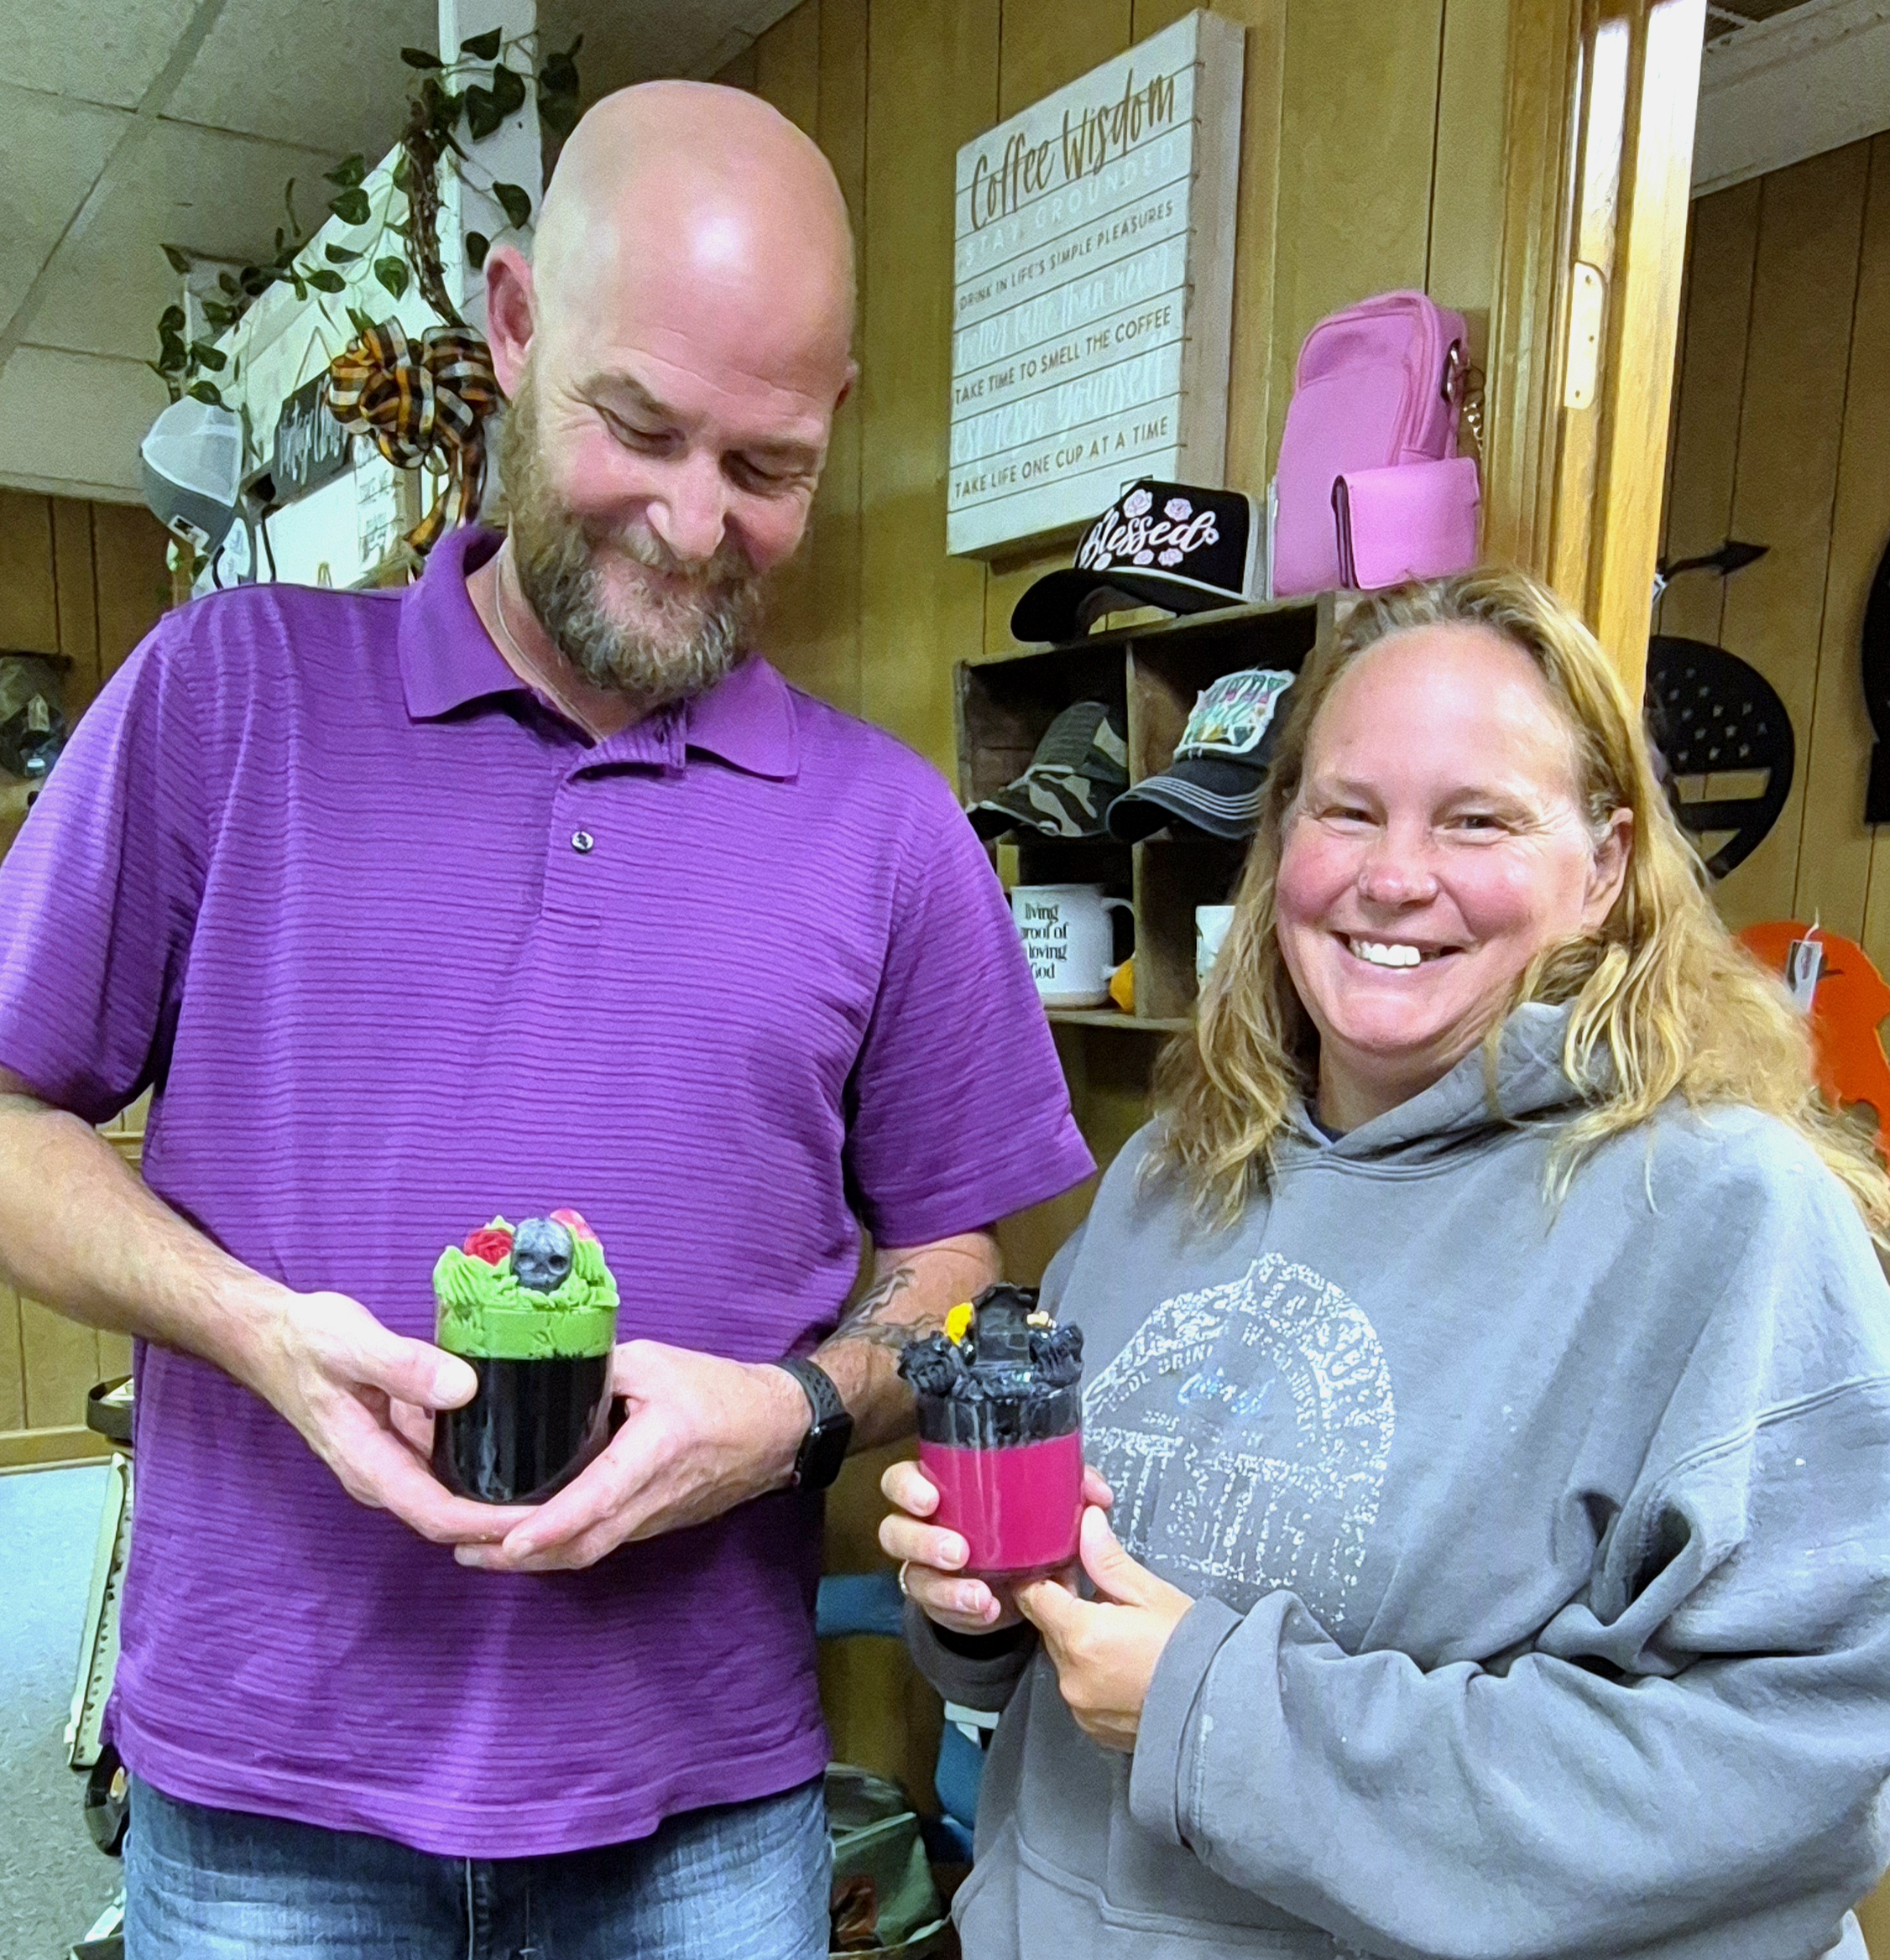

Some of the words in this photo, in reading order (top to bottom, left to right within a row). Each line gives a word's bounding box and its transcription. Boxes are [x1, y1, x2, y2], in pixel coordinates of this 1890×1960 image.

[971, 132, 1055, 231] Coffee
[1062, 68, 1174, 179] Wisdom
[964, 224, 1021, 266] STAY
[1035, 141, 1173, 228] GROUNDED
[996, 279, 1007, 295] IN
[1011, 259, 1046, 287] LIFE'S
[1050, 238, 1093, 269] SIMPLE
[1097, 200, 1173, 249] PLEASURES
[955, 380, 984, 405] TAKE
[989, 367, 1015, 392] TIME
[1020, 359, 1037, 381] TO
[1040, 343, 1080, 374] SMELL
[1086, 330, 1110, 357] THE
[1115, 305, 1172, 343] COFFEE
[955, 474, 987, 499] TAKE
[991, 464, 1017, 489] LIFE
[1021, 455, 1050, 480] ONE
[1056, 445, 1083, 469] CUP
[1090, 435, 1109, 456] AT
[1115, 433, 1125, 451] A
[1133, 416, 1168, 445] TIME
[1079, 508, 1219, 569] Blessed
[1026, 902, 1059, 923] living
[1054, 921, 1068, 939] of
[1029, 941, 1067, 962] loving
[1031, 962, 1055, 979] God
